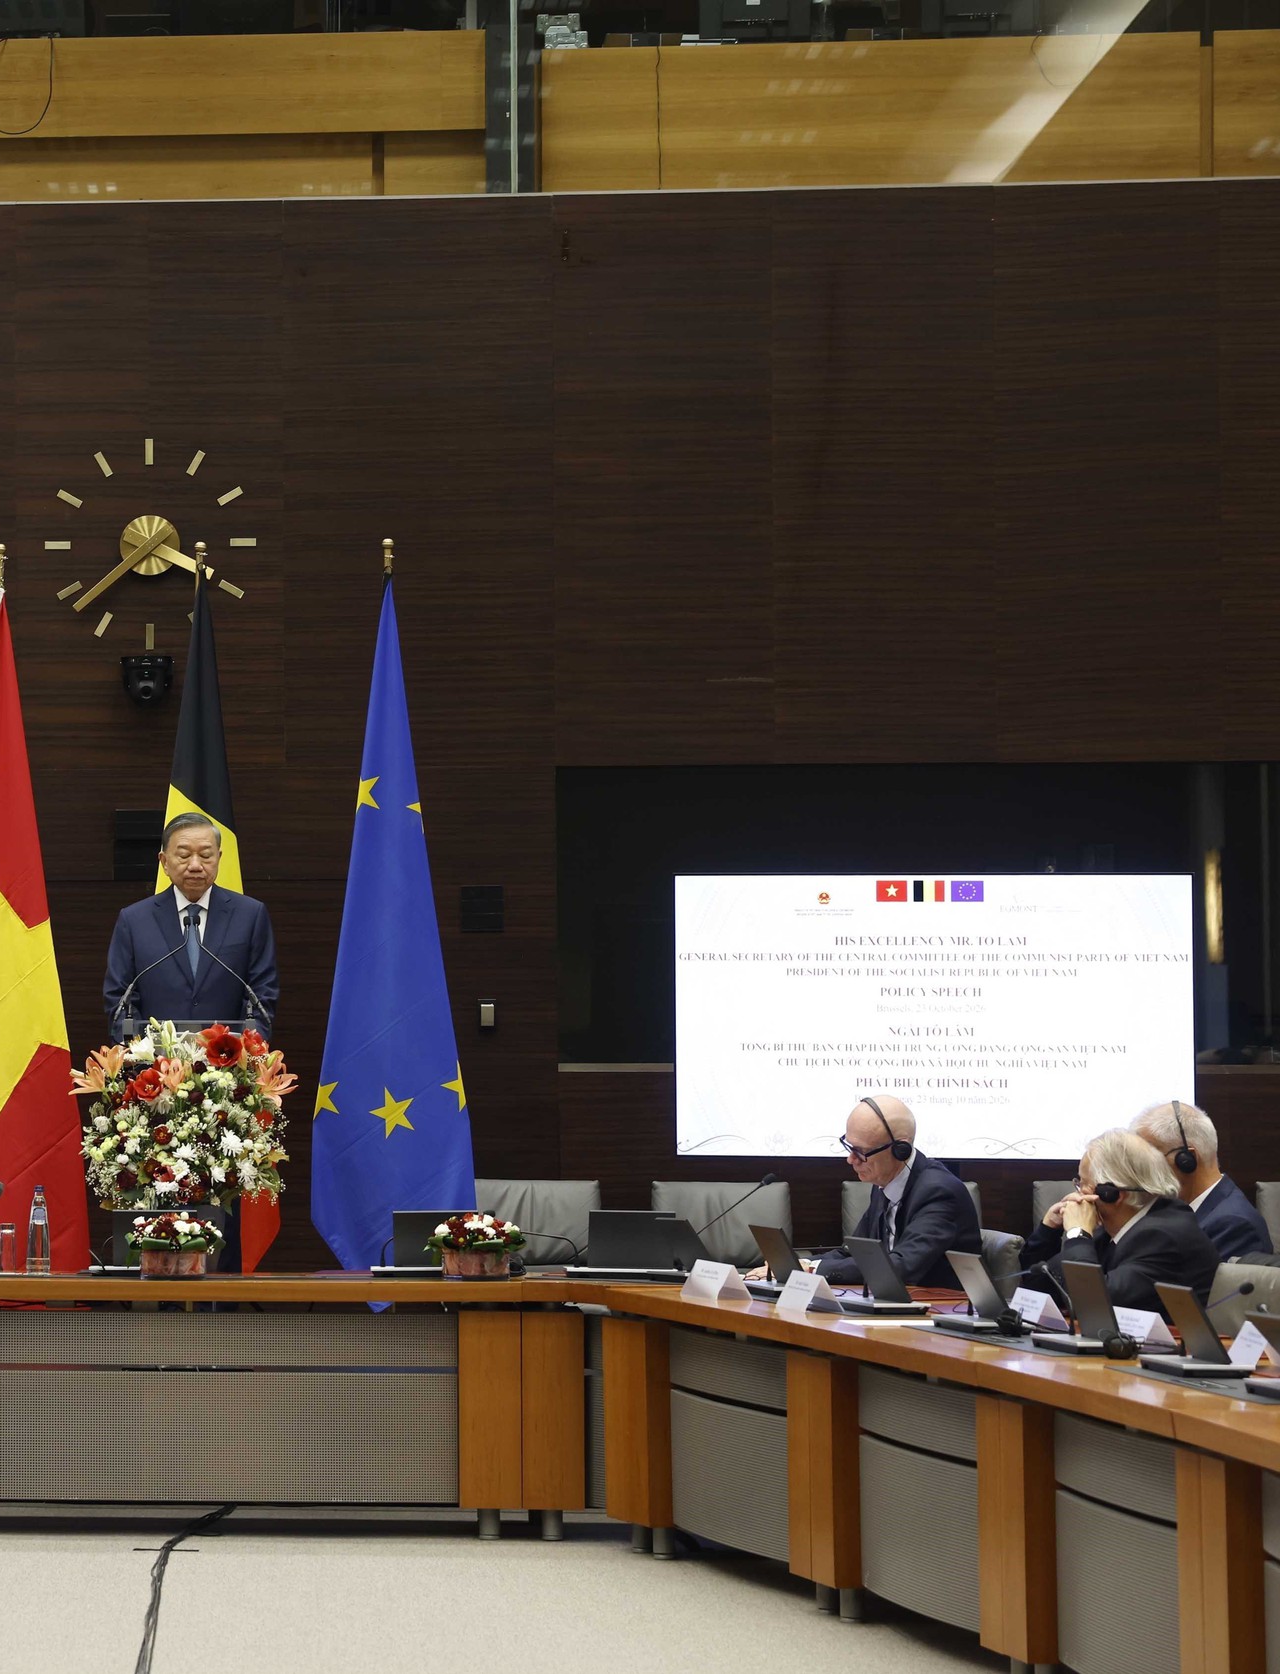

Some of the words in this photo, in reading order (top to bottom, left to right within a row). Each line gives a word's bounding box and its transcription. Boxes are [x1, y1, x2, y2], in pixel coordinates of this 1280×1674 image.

[835, 935, 856, 945] HIS
[859, 936, 945, 945] EXCELLENCY
[949, 936, 974, 945] MR.
[976, 936, 995, 945] TO
[997, 936, 1027, 945] LAM
[678, 952, 731, 961] GENERAL
[732, 952, 794, 961] SECRETARY
[797, 953, 812, 961] OF
[815, 952, 836, 961] THE
[838, 952, 889, 961] CENTRAL
[891, 953, 959, 962] COMMITTEE
[962, 953, 977, 962] OF
[980, 953, 1001, 962] THE
[1004, 953, 1073, 962] COMMUNIST
[1076, 953, 1111, 962] PARTY
[1114, 953, 1129, 962] OF
[1134, 953, 1161, 962] VIET
[1163, 953, 1189, 962] NAM
[786, 967, 846, 976] PRESIDENT
[847, 968, 862, 976] OF
[865, 968, 886, 977] THE
[889, 968, 946, 977] SOCIALIST
[949, 968, 1002, 977] REPUBLIC
[1023, 968, 1049, 977] VIET
[1051, 968, 1077, 977] NAM
[880, 987, 927, 996] POLICY
[931, 987, 982, 996] SPEECH
[812, 1043, 835, 1052] BAN
[903, 1043, 942, 1052] TRUNG
[1100, 1045, 1127, 1054] NAM
[1061, 1059, 1088, 1068] NAM
